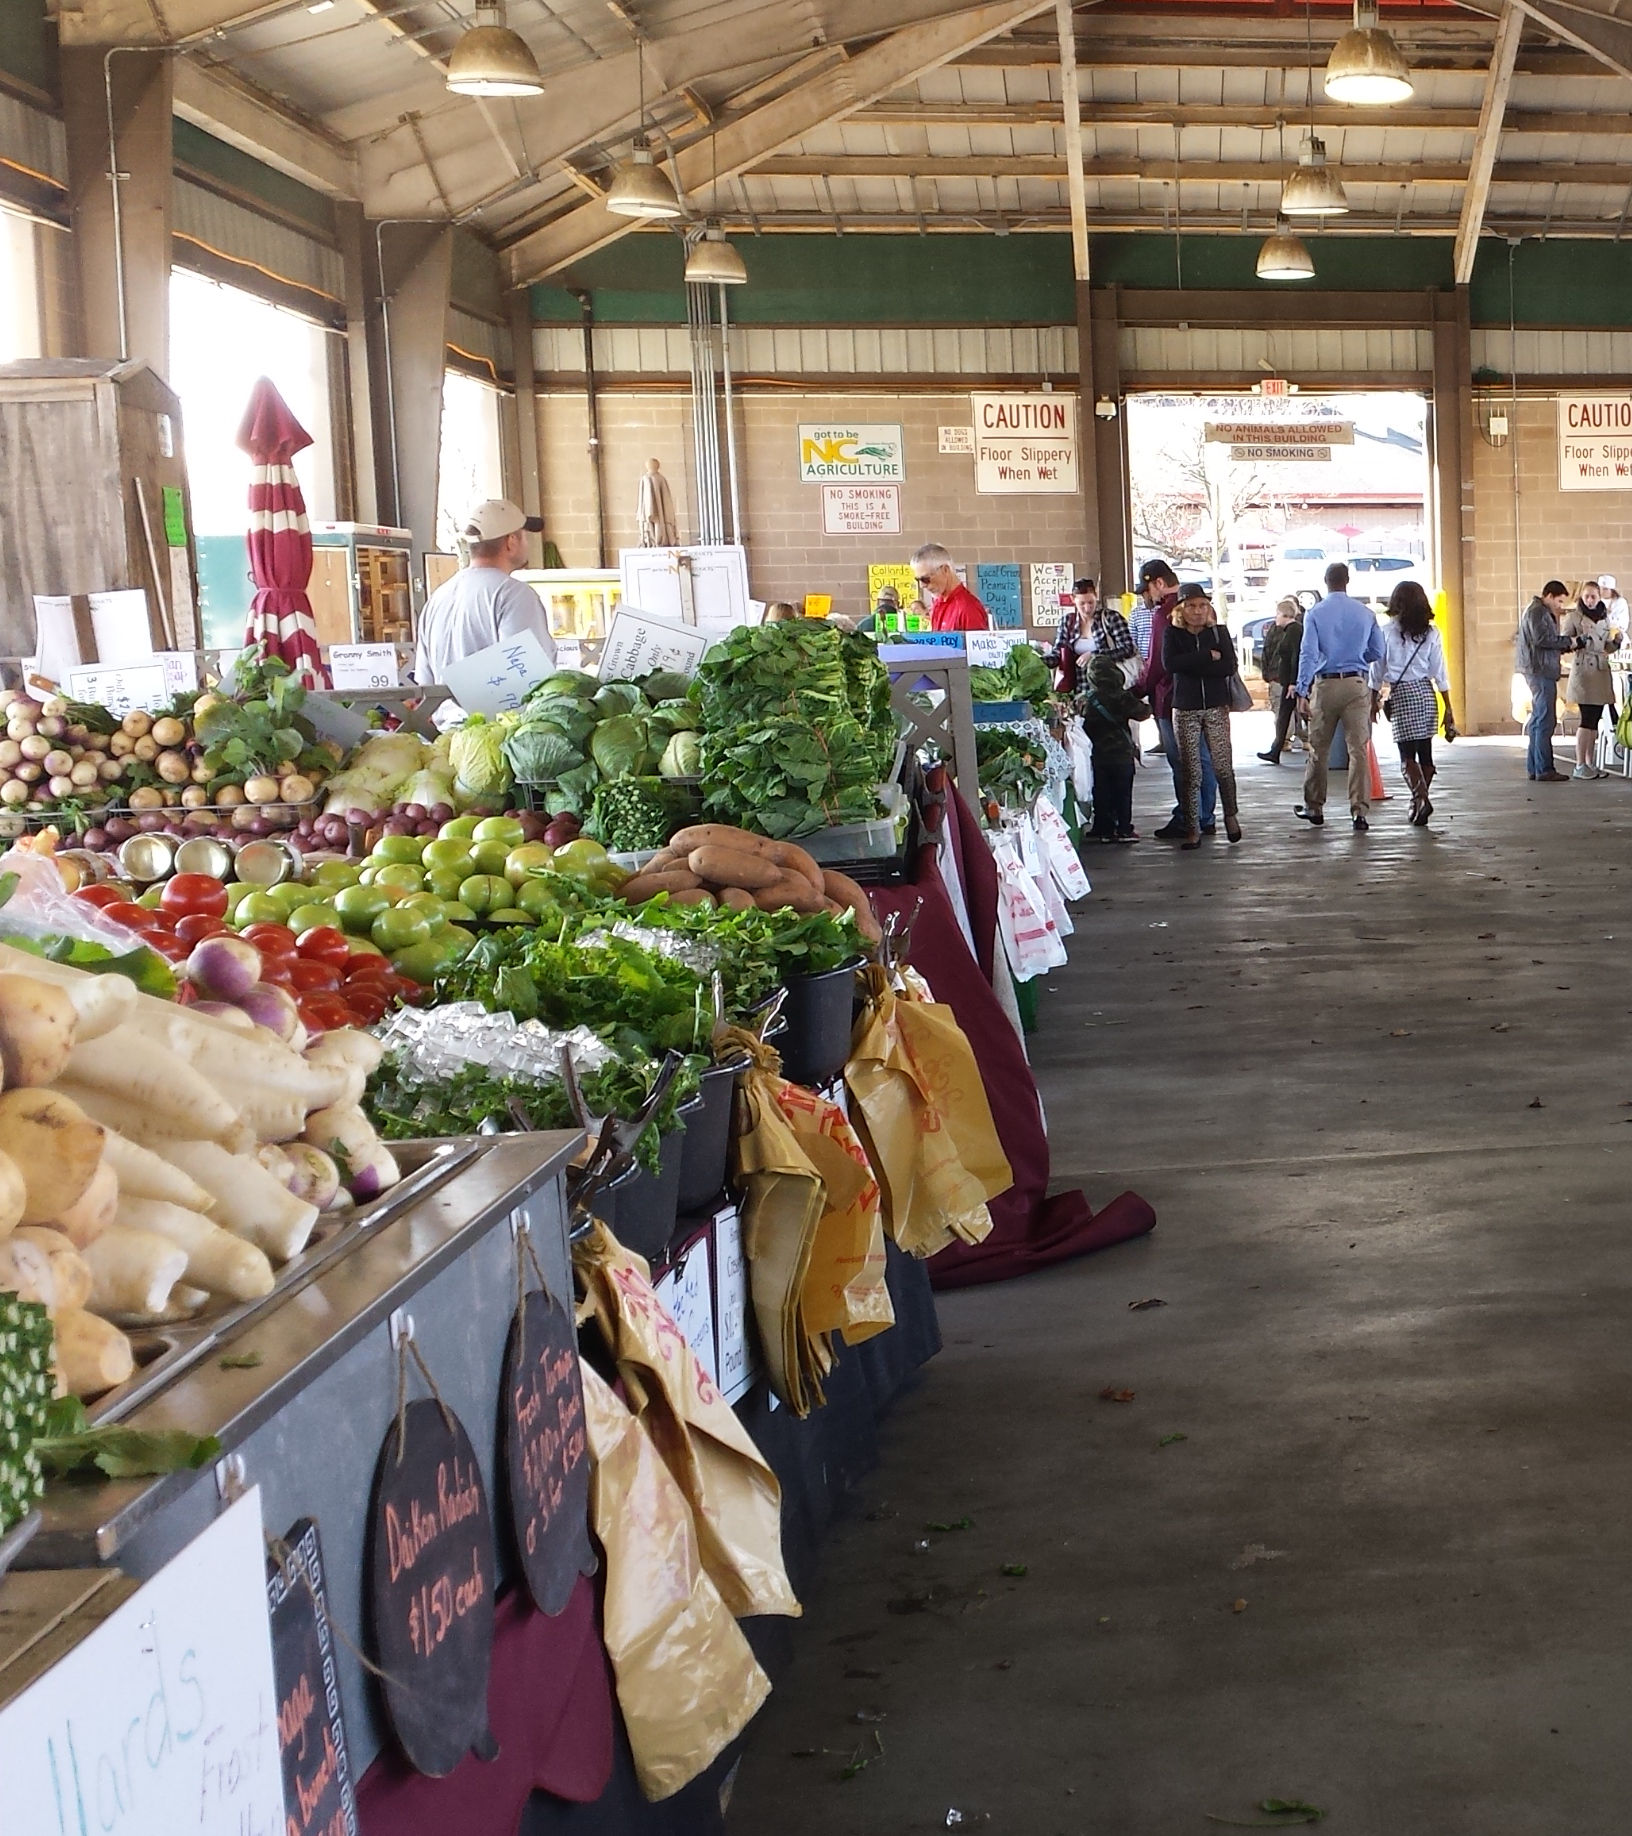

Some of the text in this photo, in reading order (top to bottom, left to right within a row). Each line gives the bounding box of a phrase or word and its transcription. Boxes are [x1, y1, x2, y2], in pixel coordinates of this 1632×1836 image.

[1266, 382, 1283, 394] EXIT
[983, 403, 1065, 429] CAUTION
[814, 430, 859, 440] got to be
[1235, 425, 1285, 433] ANIMALS
[1288, 425, 1342, 433] ALLOWED
[802, 439, 859, 464] NC
[980, 447, 1072, 464] Floor Slippery
[1248, 449, 1315, 457] NO SMOKING
[1565, 445, 1594, 459] Floor
[806, 464, 899, 475] AGRICULTURE
[998, 466, 1058, 480] When Wet
[1579, 463, 1609, 476] When
[830, 490, 891, 499] NO SMOKING
[838, 512, 890, 520] SMOKE-FREE
[846, 522, 883, 530] BUILDING
[871, 565, 910, 576] Collards
[977, 564, 999, 578] Local
[1034, 564, 1053, 574] We
[981, 578, 1016, 590] Peanuts
[1033, 576, 1069, 587] Accept
[1034, 586, 1067, 595] Credit
[986, 592, 1006, 605] Dug
[941, 636, 958, 648] Pay
[972, 639, 997, 650] Make
[333, 651, 362, 659] Granny
[607, 641, 624, 671] Grown
[620, 628, 647, 679] Cabbage
[647, 644, 663, 667] Only
[684, 652, 695, 673] ound
[368, 675, 389, 687] .99
[515, 1371, 541, 1443] Fresh
[386, 1456, 479, 1583] Daikon Radish
[408, 1546, 483, 1657] $1.50 each
[48, 1609, 205, 1836] llards
